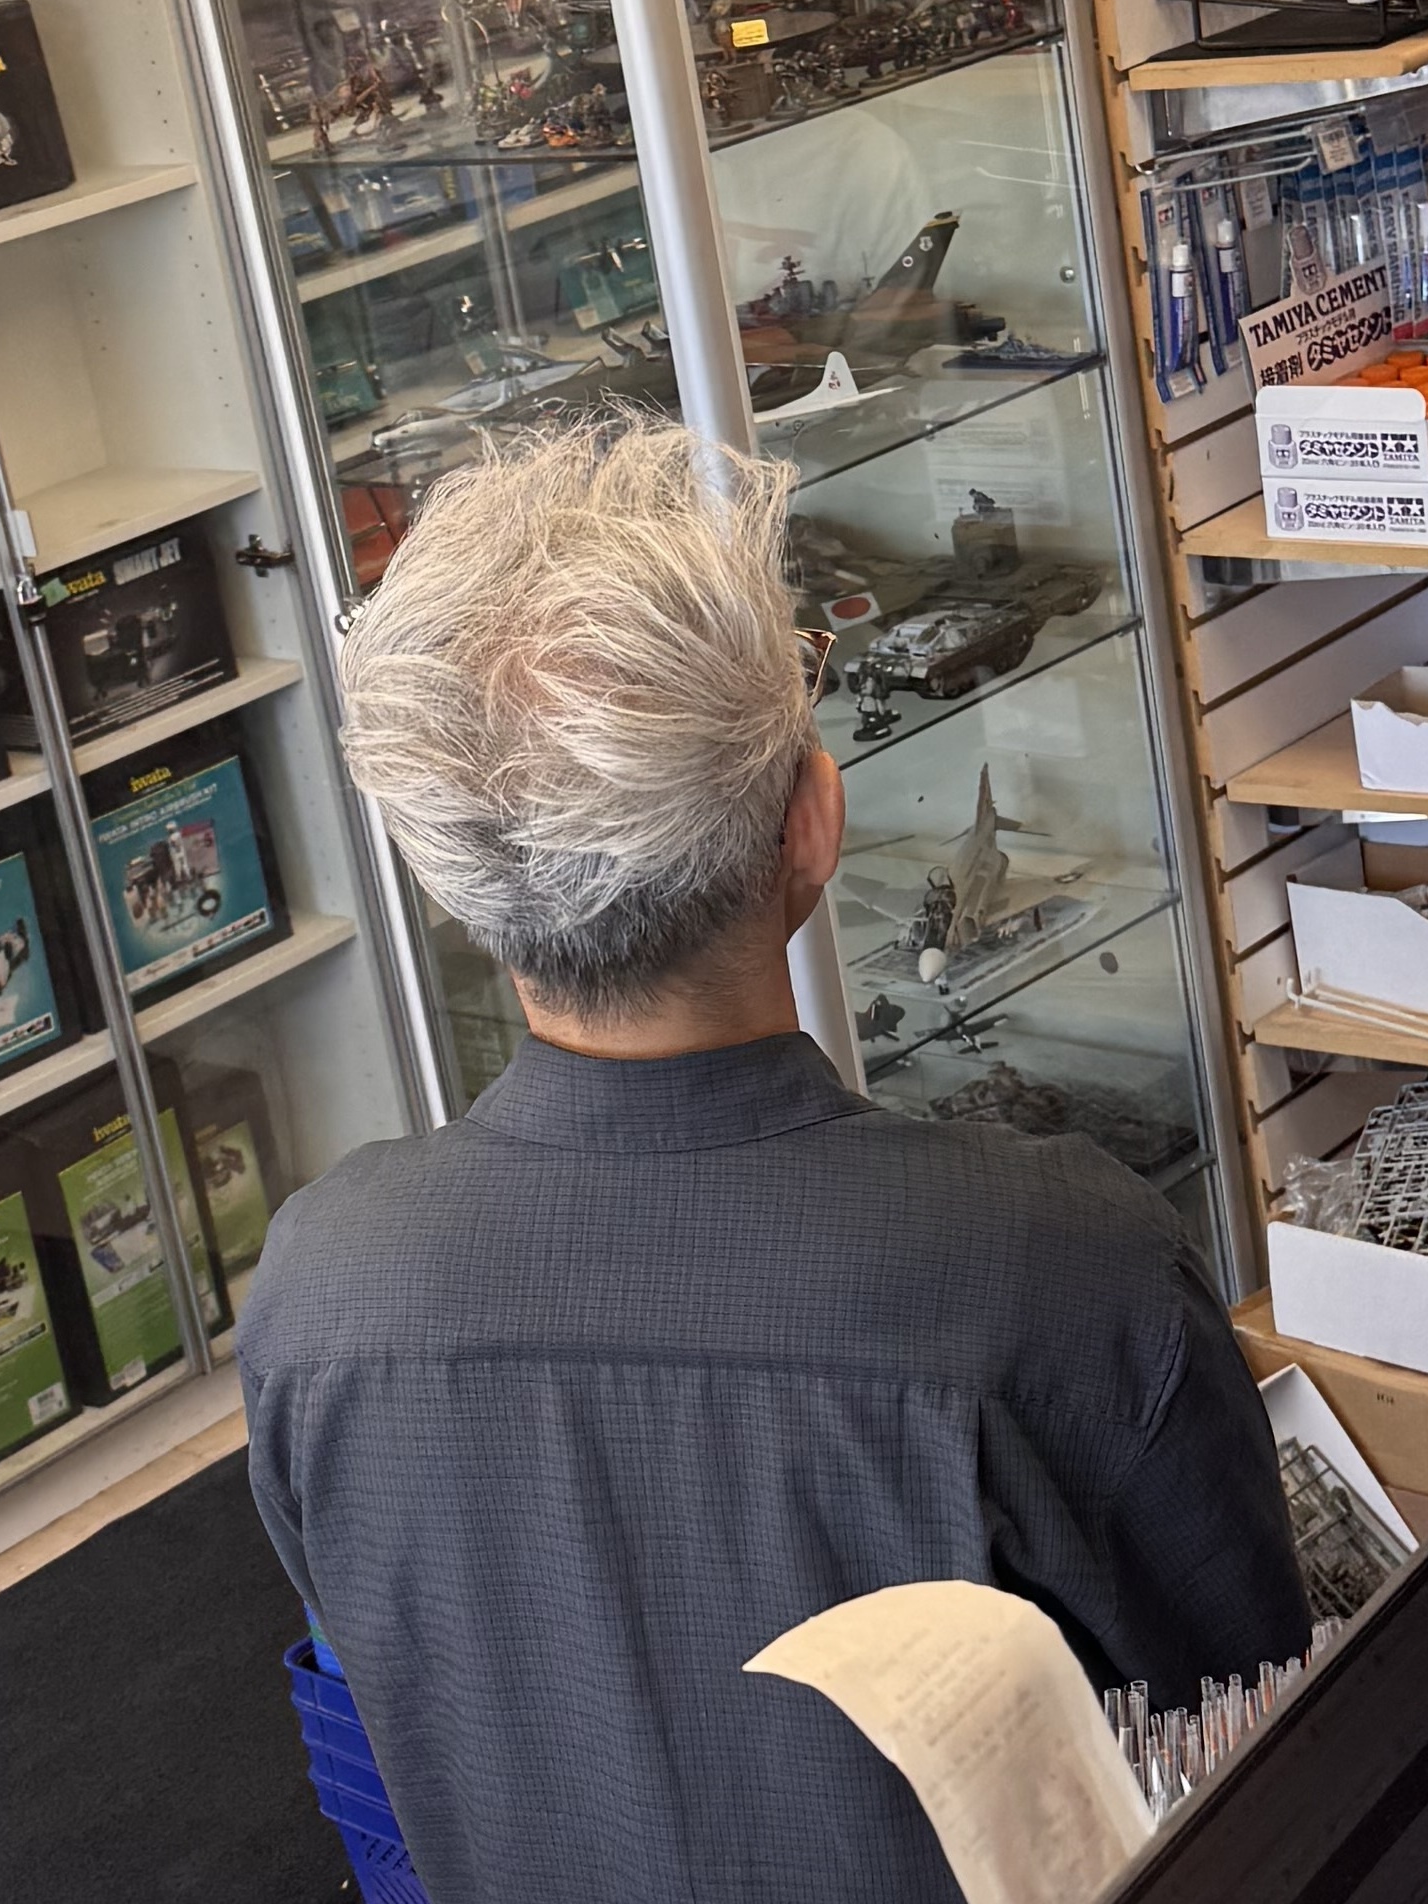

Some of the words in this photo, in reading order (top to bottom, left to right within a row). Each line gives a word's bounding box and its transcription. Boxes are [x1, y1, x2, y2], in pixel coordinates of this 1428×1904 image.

[1249, 300, 1315, 349] TAMIYA
[1316, 265, 1390, 320] CEMENT
[1382, 453, 1420, 462] TAMIYA
[1389, 517, 1426, 526] TAMIYA
[130, 766, 172, 794] iwata
[158, 796, 200, 822] AIRBRUSH
[202, 782, 219, 800] KIT
